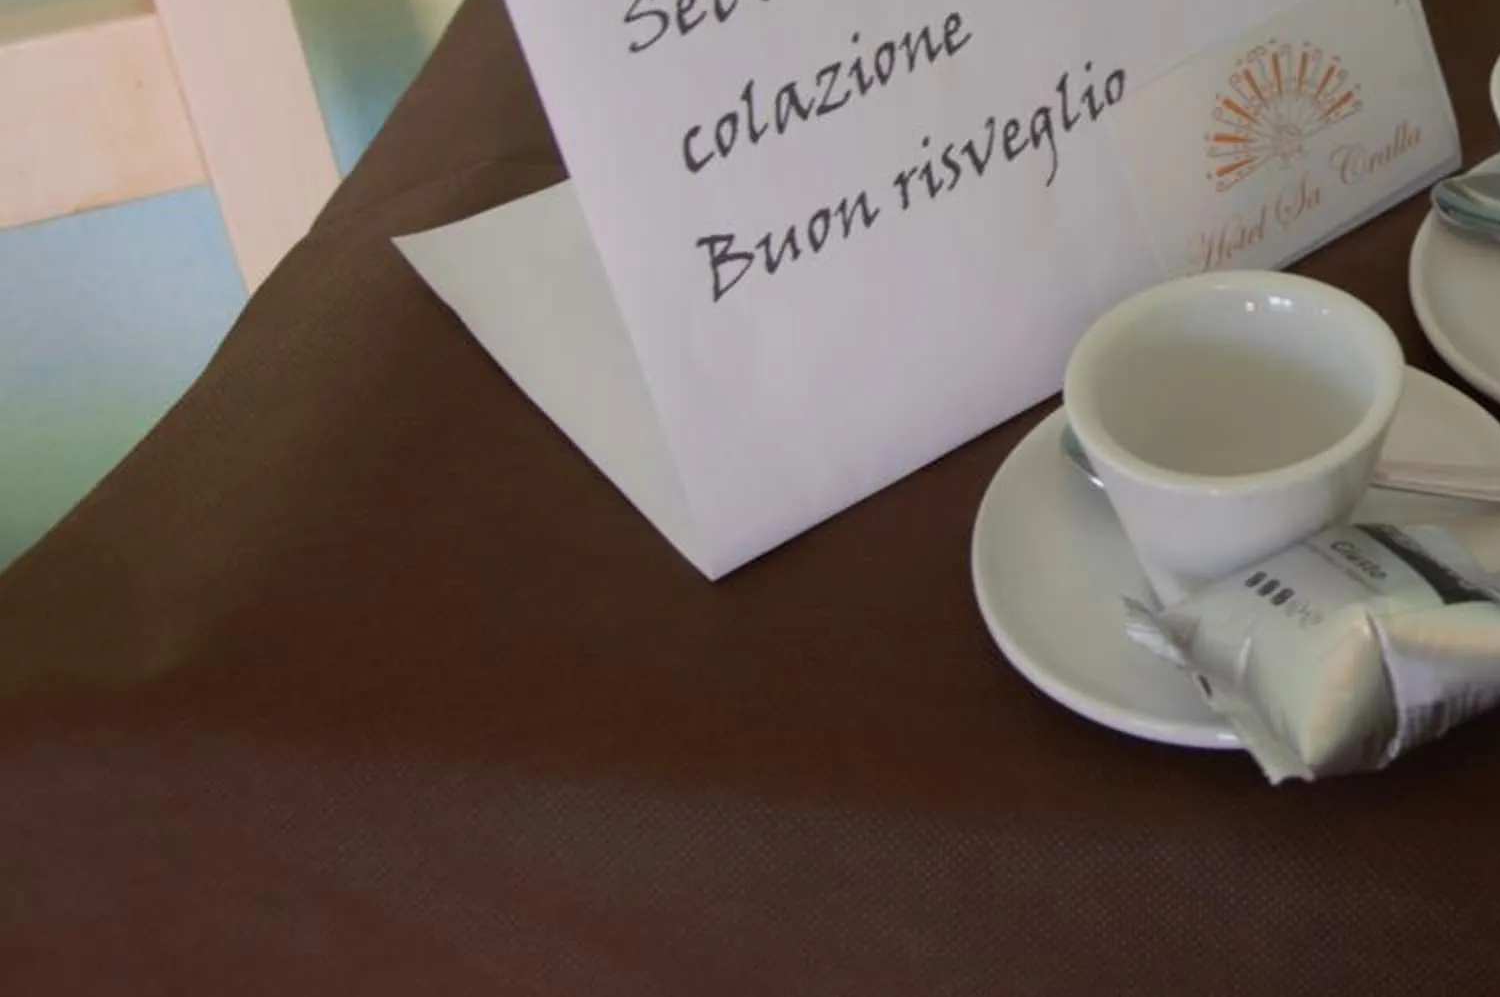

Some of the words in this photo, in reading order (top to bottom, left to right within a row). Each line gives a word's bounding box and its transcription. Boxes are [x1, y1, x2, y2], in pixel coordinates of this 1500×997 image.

[681, 11, 972, 173] colazione
[696, 189, 881, 303] Buon
[892, 60, 1127, 210] risveglio
